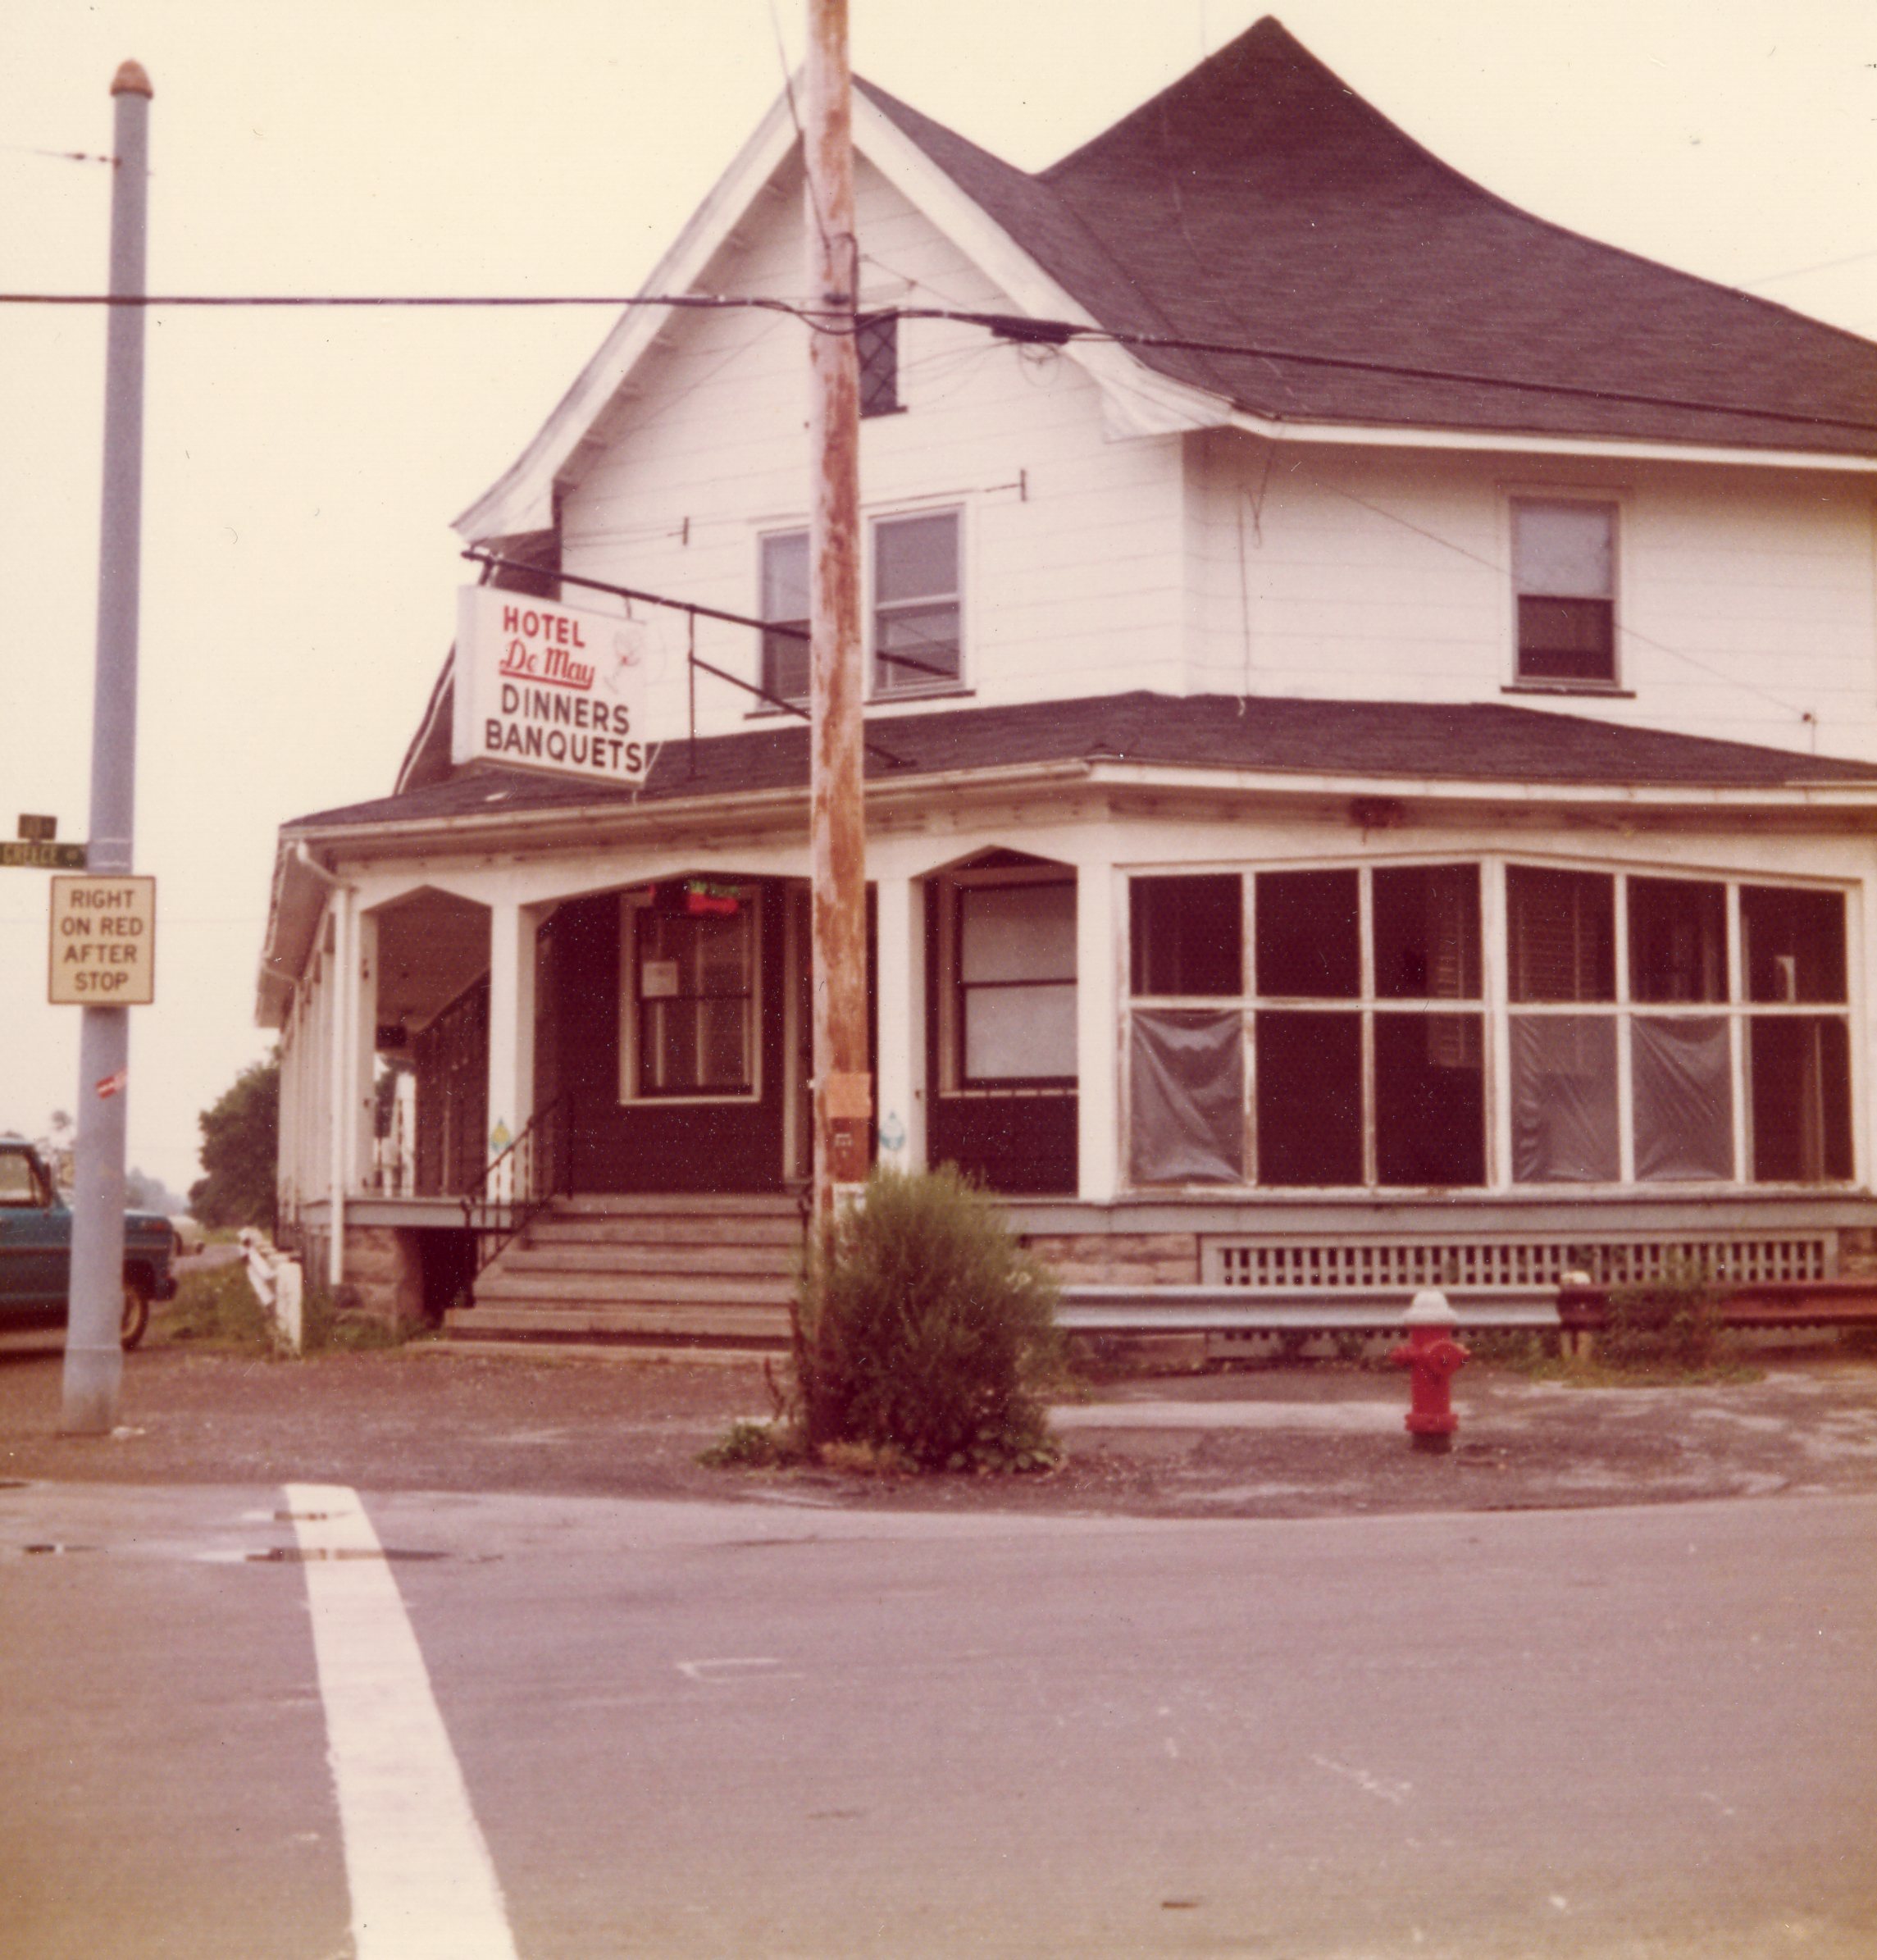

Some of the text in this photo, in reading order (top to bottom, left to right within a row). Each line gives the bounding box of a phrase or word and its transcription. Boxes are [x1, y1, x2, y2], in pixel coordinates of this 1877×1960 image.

[503, 604, 585, 649] HOTEL
[499, 638, 595, 690] De May
[501, 682, 631, 736] DINNERS
[485, 718, 642, 774] BANQUETS
[71, 888, 134, 909] RIGHT
[61, 916, 144, 937] ON RED
[63, 944, 138, 964] AFTER
[75, 971, 129, 991] STOP
